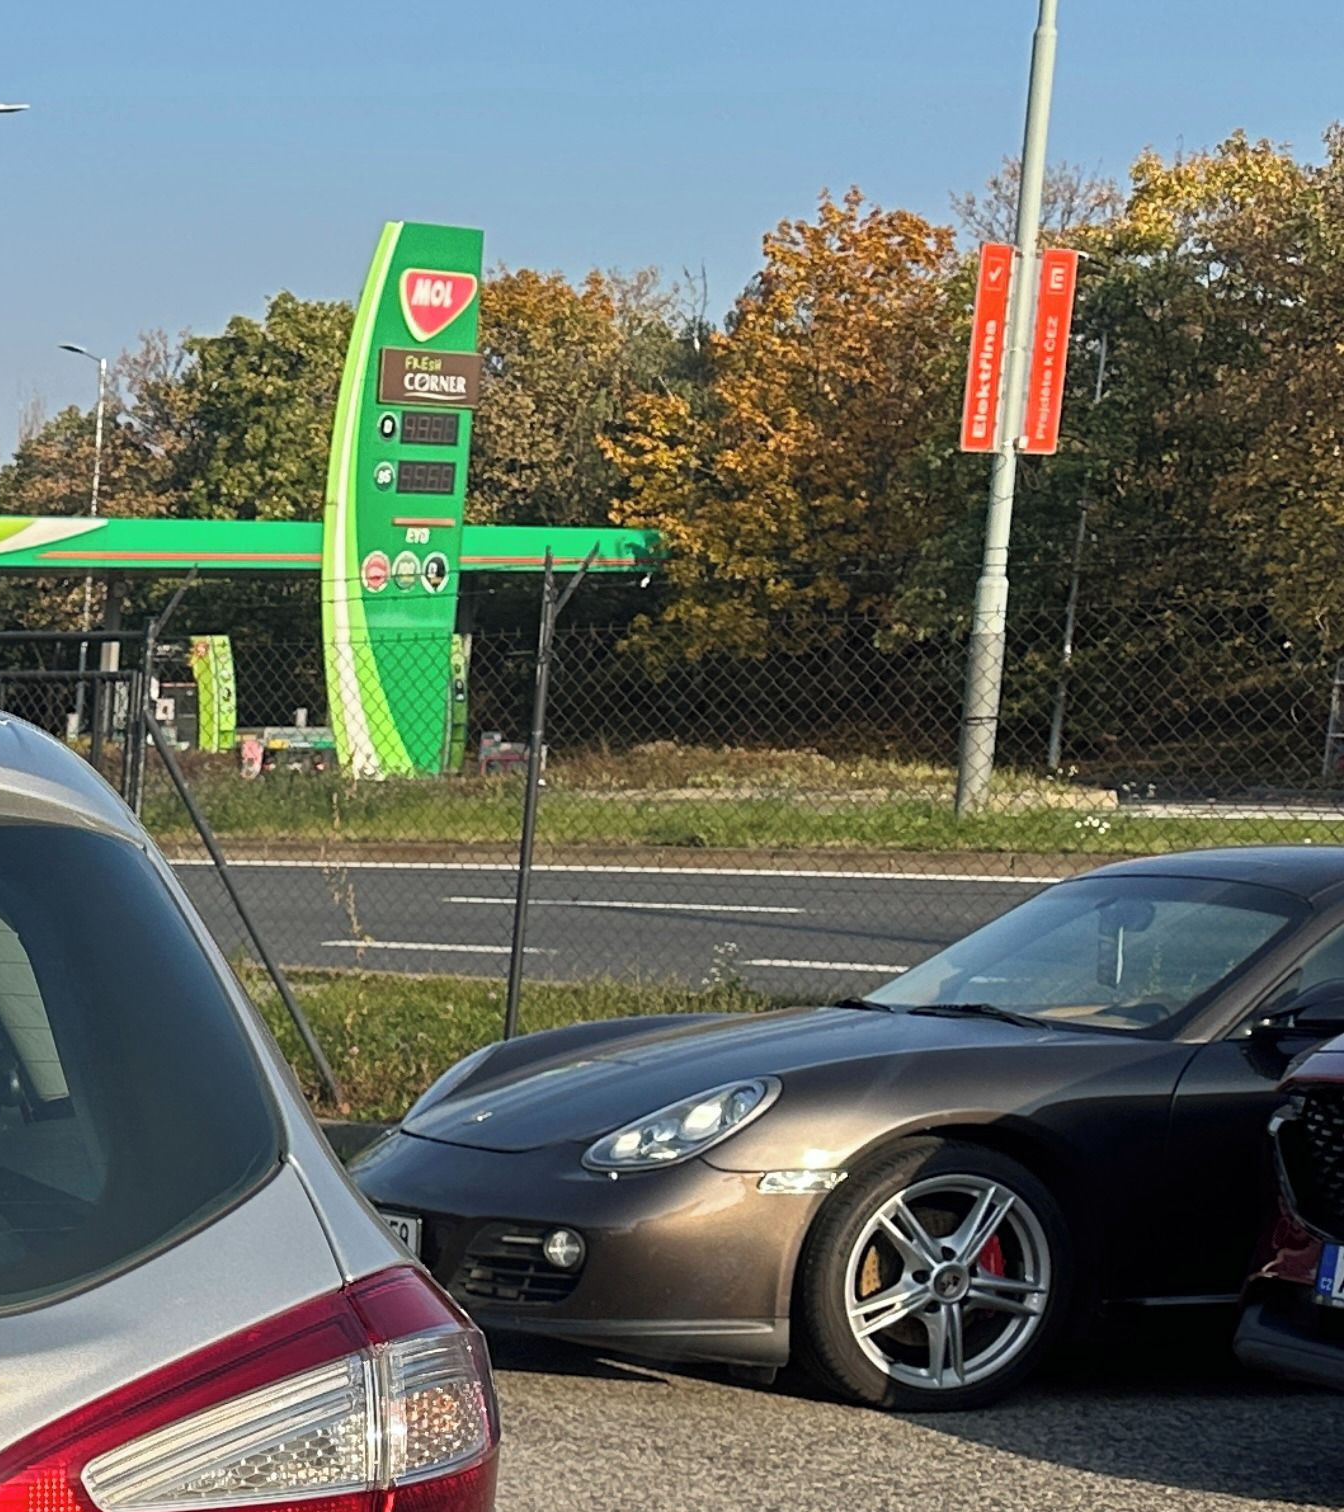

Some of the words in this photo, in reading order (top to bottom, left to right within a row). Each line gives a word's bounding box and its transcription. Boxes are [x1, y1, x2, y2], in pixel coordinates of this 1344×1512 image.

[411, 277, 454, 308] MOL
[404, 355, 443, 371] FRESH
[403, 372, 467, 394] CORNER
